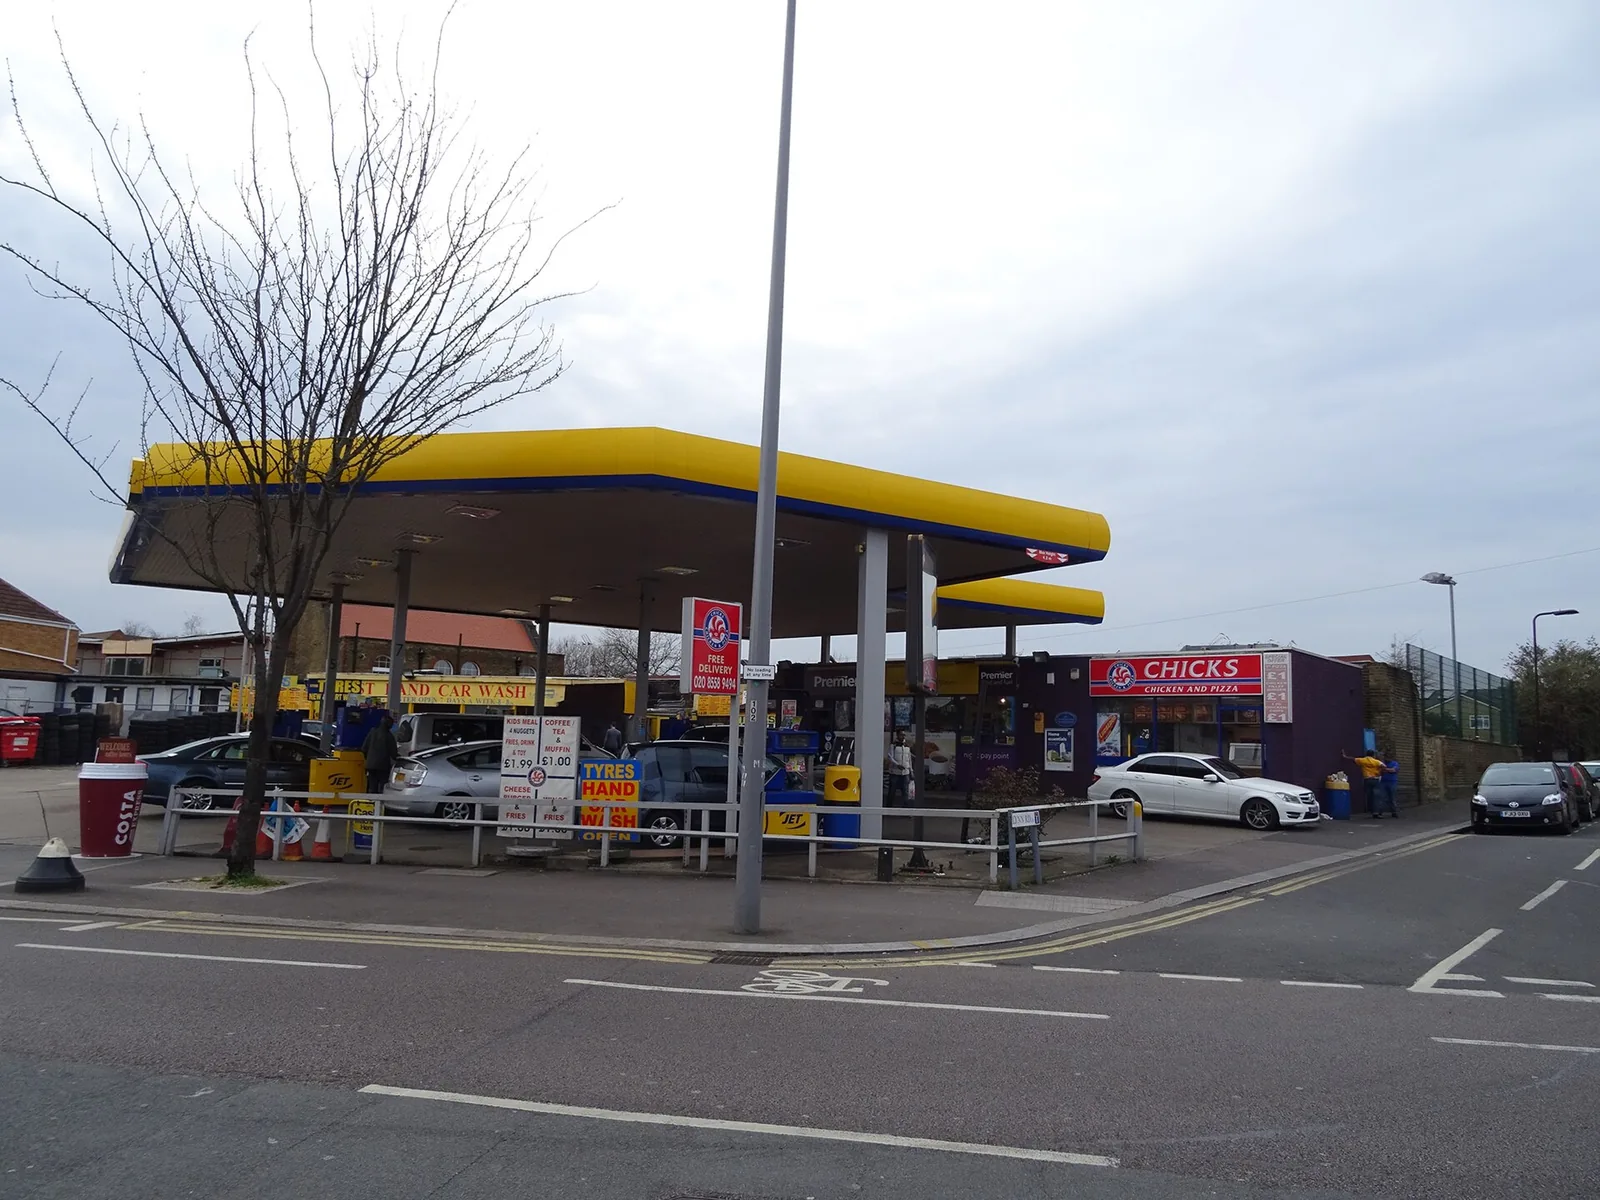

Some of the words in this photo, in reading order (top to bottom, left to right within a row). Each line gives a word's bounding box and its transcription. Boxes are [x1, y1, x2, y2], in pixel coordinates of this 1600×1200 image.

[396, 644, 403, 656] 7
[707, 654, 725, 664] FREE
[698, 664, 733, 674] DELIVERY
[1144, 659, 1239, 679] CHICKS
[980, 671, 1014, 680] Premier
[1267, 671, 1286, 680] £1
[317, 679, 362, 693] TRES
[694, 675, 706, 689] 020
[722, 677, 736, 690] 9494
[439, 684, 471, 698] CAR
[479, 685, 527, 699] WASH
[1267, 692, 1286, 700] £1
[542, 756, 571, 766] £1.00
[980, 753, 992, 761] pay
[993, 752, 1010, 760] point
[504, 759, 533, 769] £1.99
[584, 763, 635, 779] TYRES
[330, 777, 351, 786] JET
[583, 782, 635, 796] HAND
[355, 808, 375, 816] Cas
[115, 790, 136, 845] COSTA
[782, 814, 803, 824] JET
